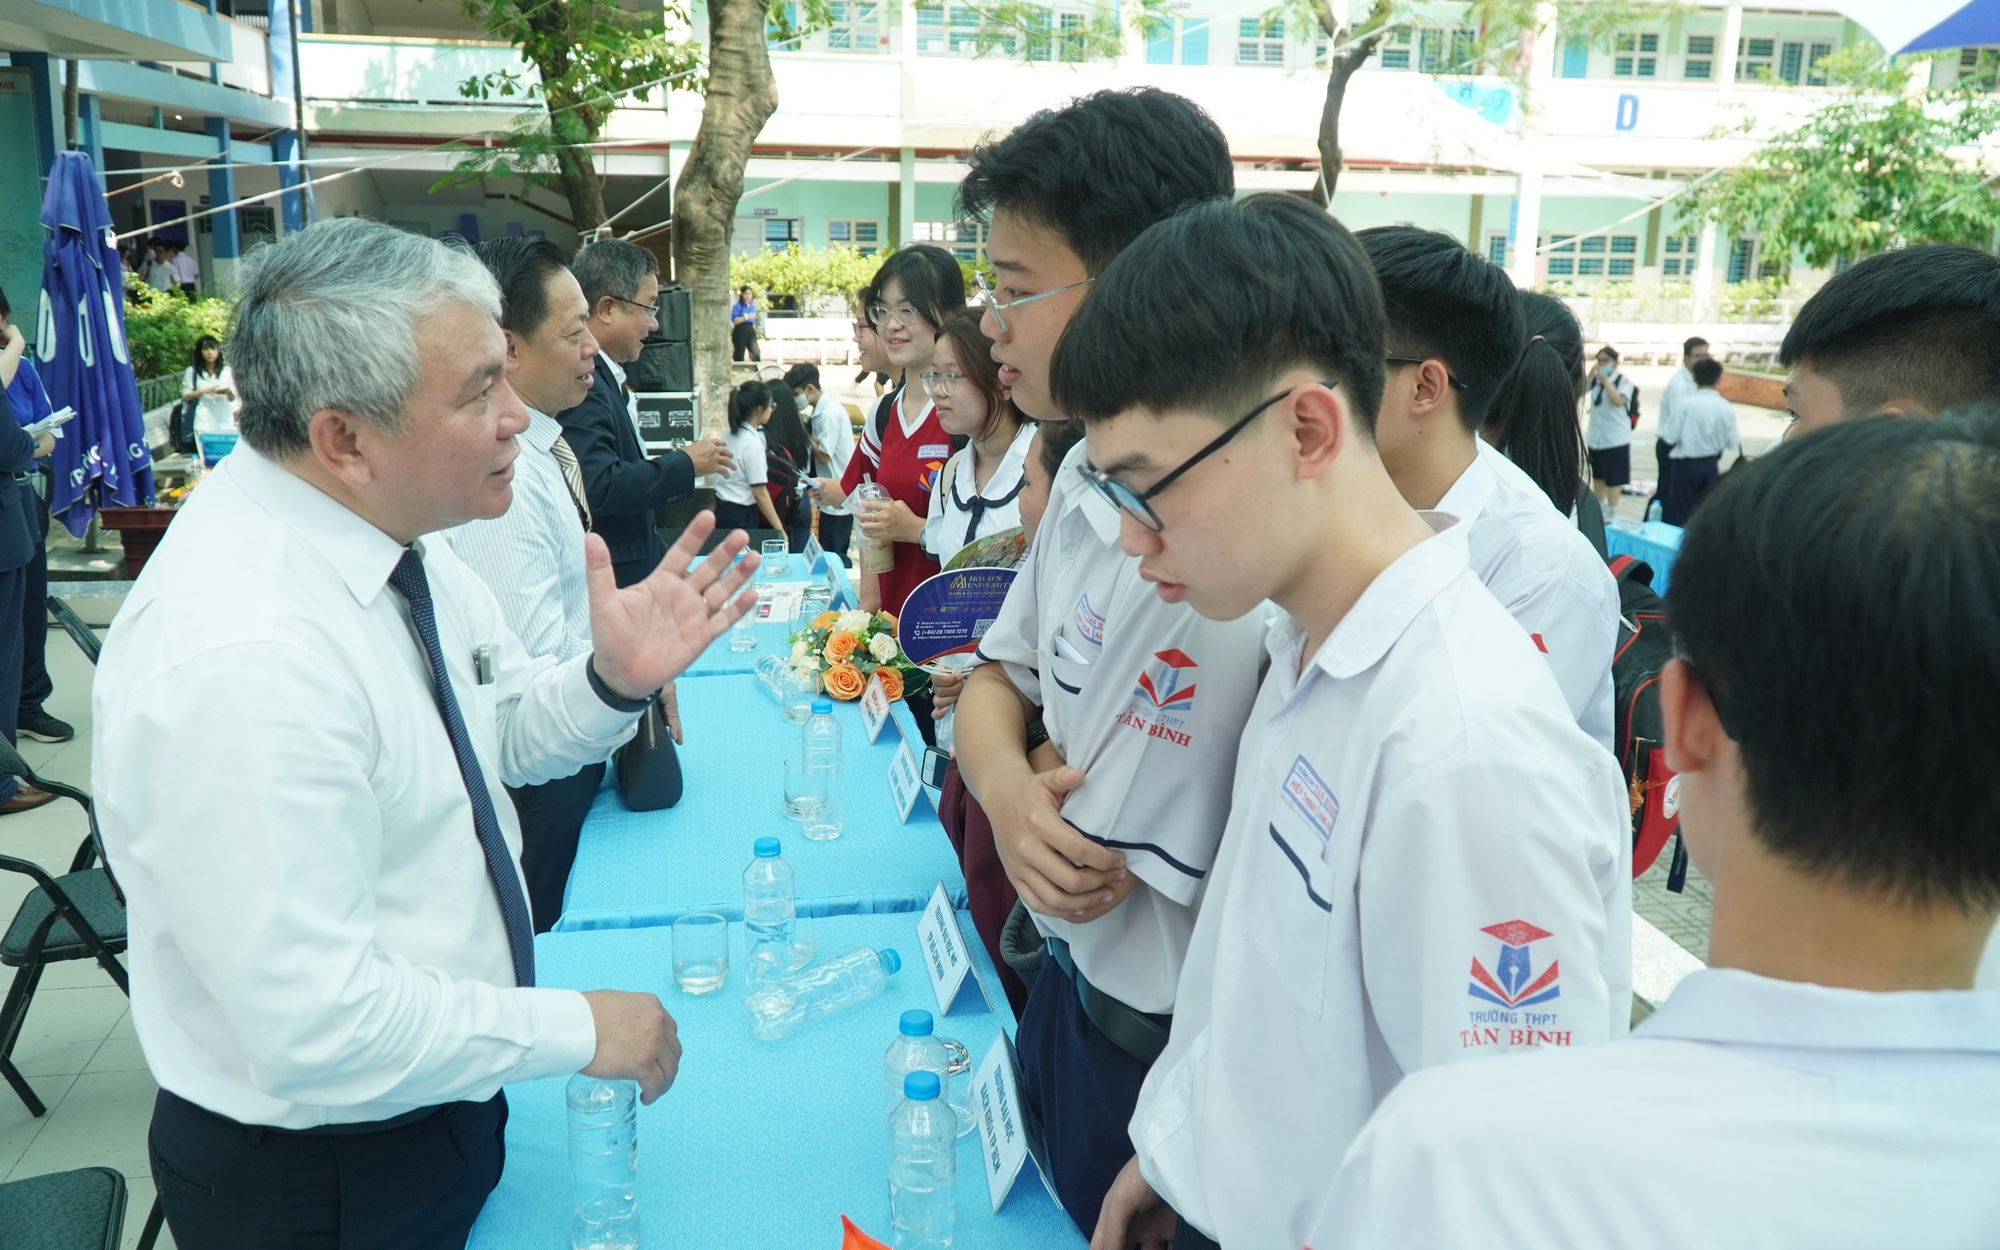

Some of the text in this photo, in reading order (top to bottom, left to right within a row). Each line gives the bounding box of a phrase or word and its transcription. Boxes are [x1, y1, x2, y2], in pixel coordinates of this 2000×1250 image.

[1616, 93, 1639, 131] D
[1116, 710, 1192, 747] TÂN BÌNH
[1162, 714, 1185, 729] THPT
[1469, 1008, 1558, 1025] TRƯỜNG THPT
[1460, 1024, 1572, 1048] TÂN BÌNH
[1000, 1098, 1010, 1123] ĐẠI
[980, 1082, 1001, 1175] BÁCH KHOA TP HCM
[1003, 1118, 1015, 1144] HỌC
